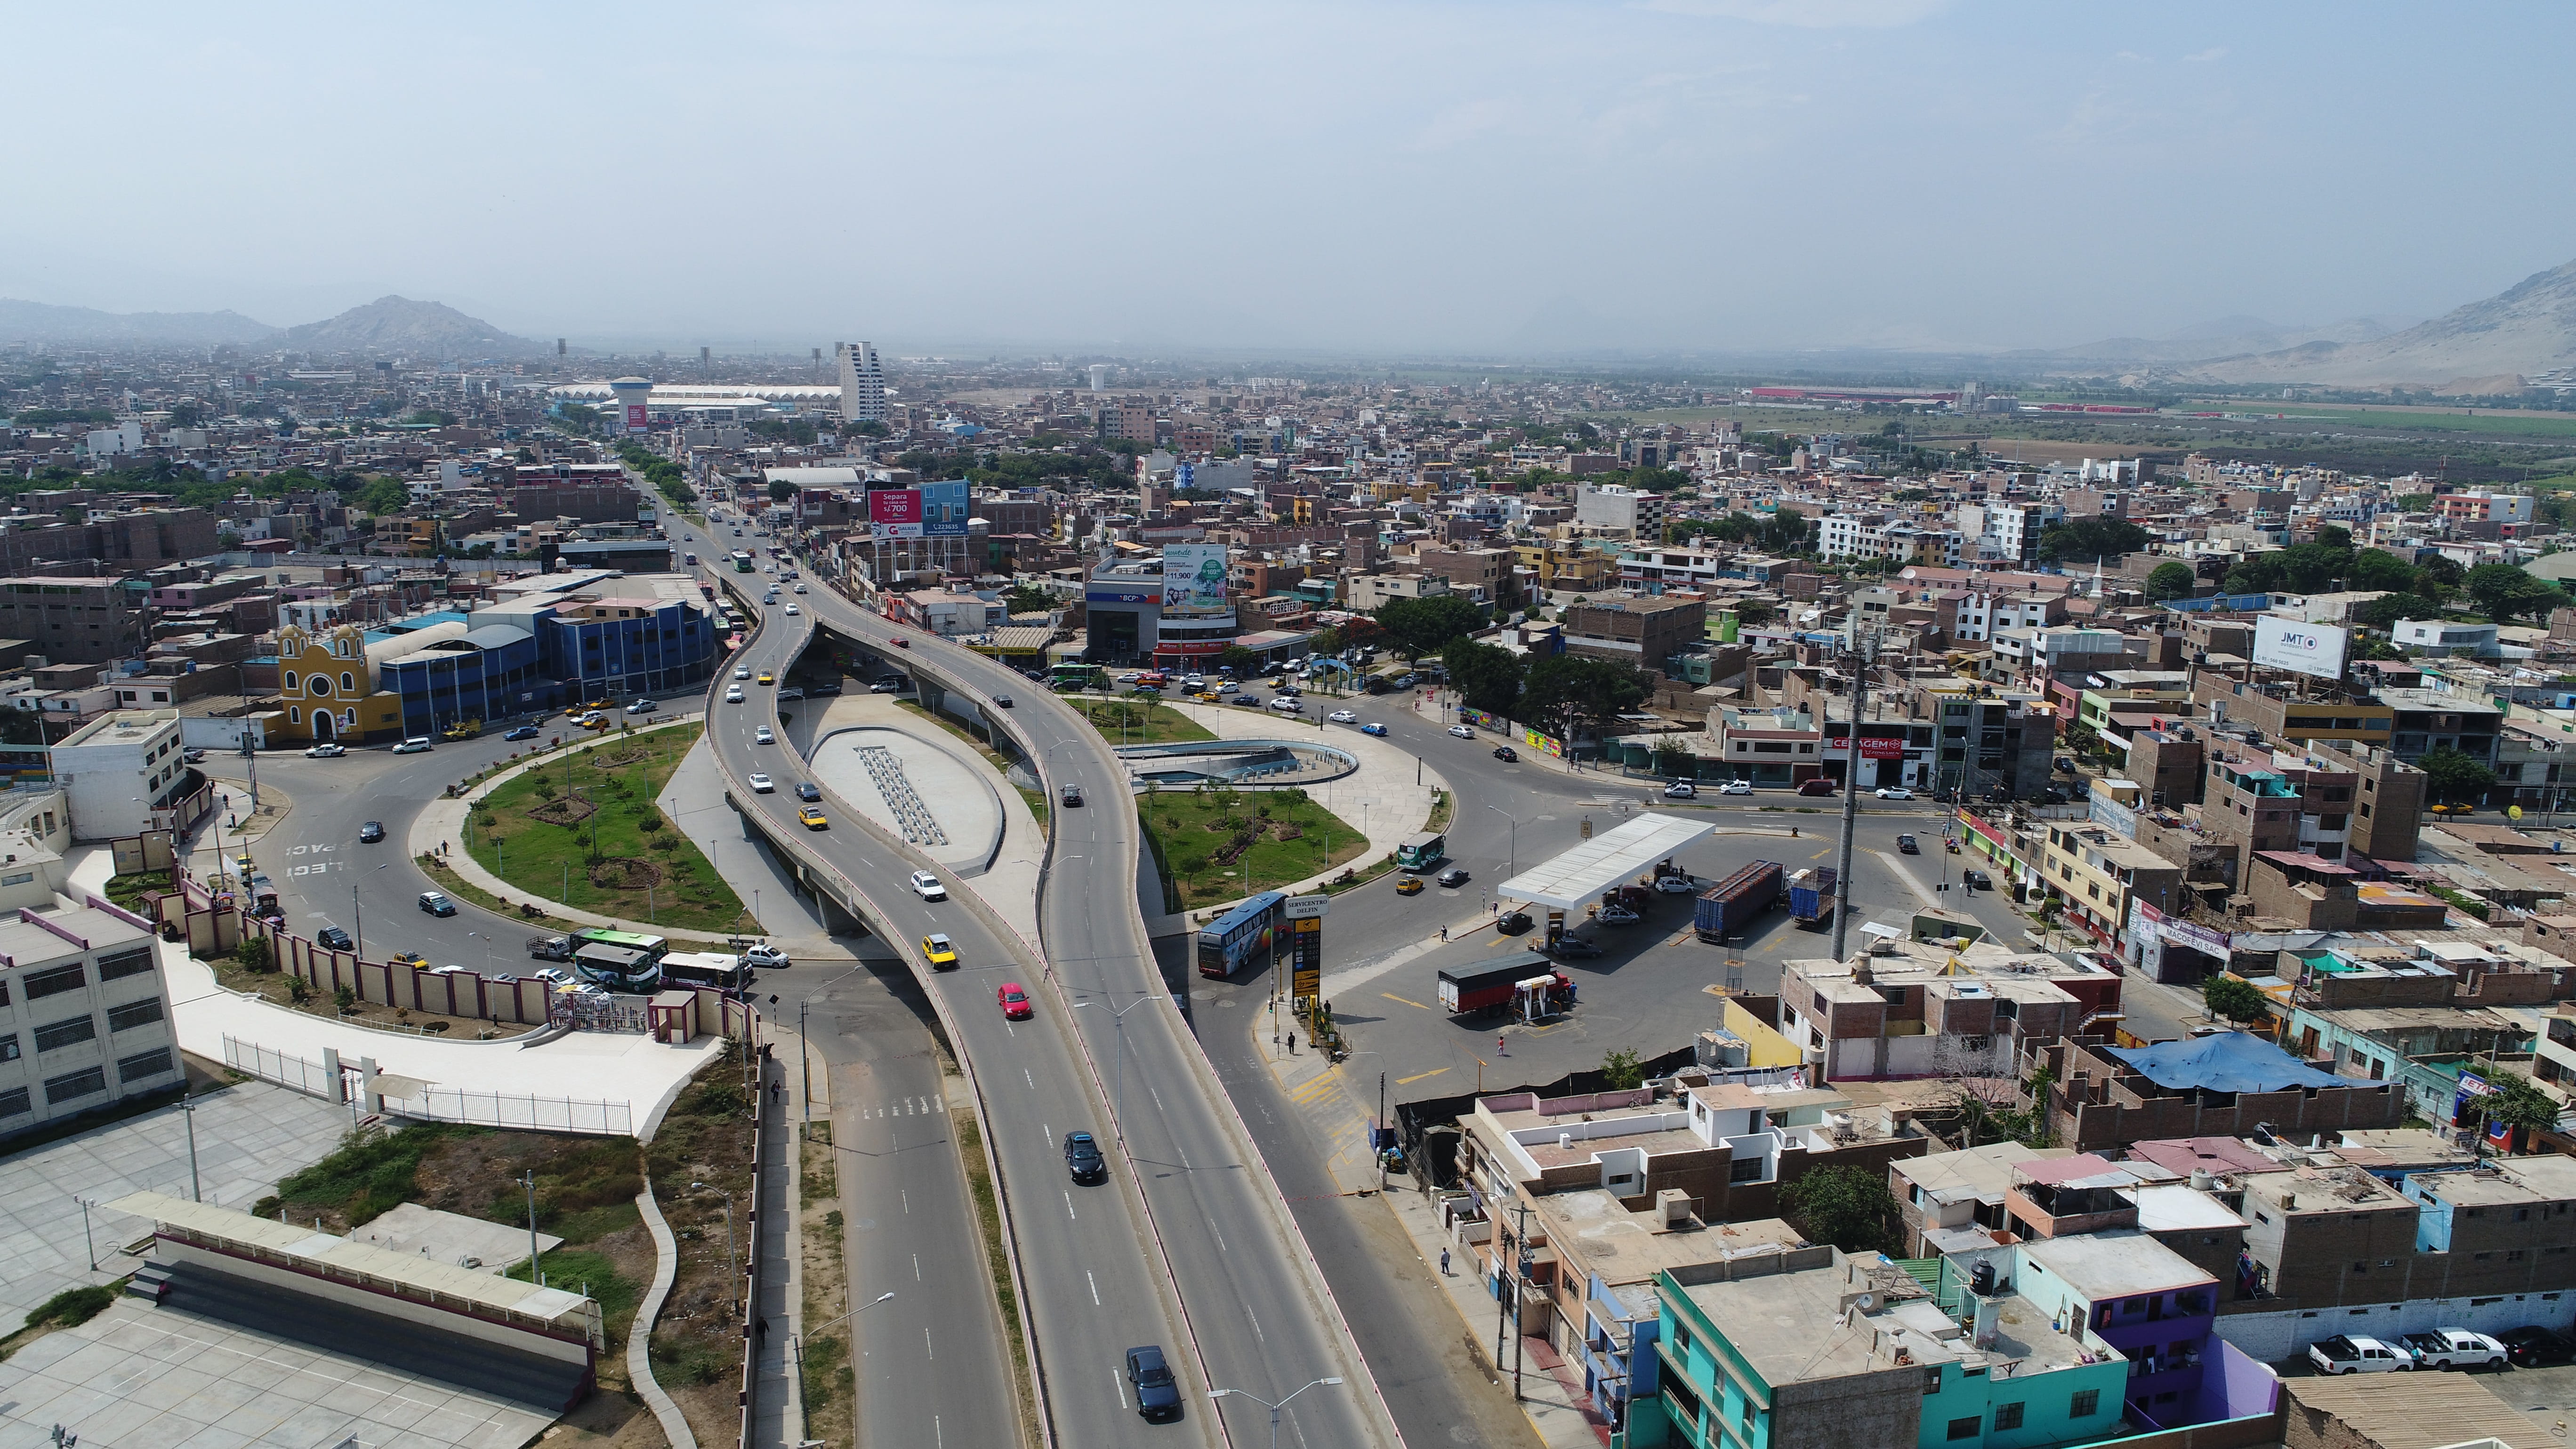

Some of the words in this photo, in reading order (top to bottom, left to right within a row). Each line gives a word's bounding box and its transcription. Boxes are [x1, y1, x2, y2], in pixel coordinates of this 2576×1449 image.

[1271, 601, 1302, 614] FERRETERIA
[2281, 632, 2304, 645] JMT
[1834, 740, 1888, 748] CEAGEM
[1288, 899, 1328, 908] SERVICENTRO
[2182, 922, 2217, 939] SIDERPERU
[2166, 928, 2203, 948] MACOFEVI
[2204, 943, 2219, 955] SAC
